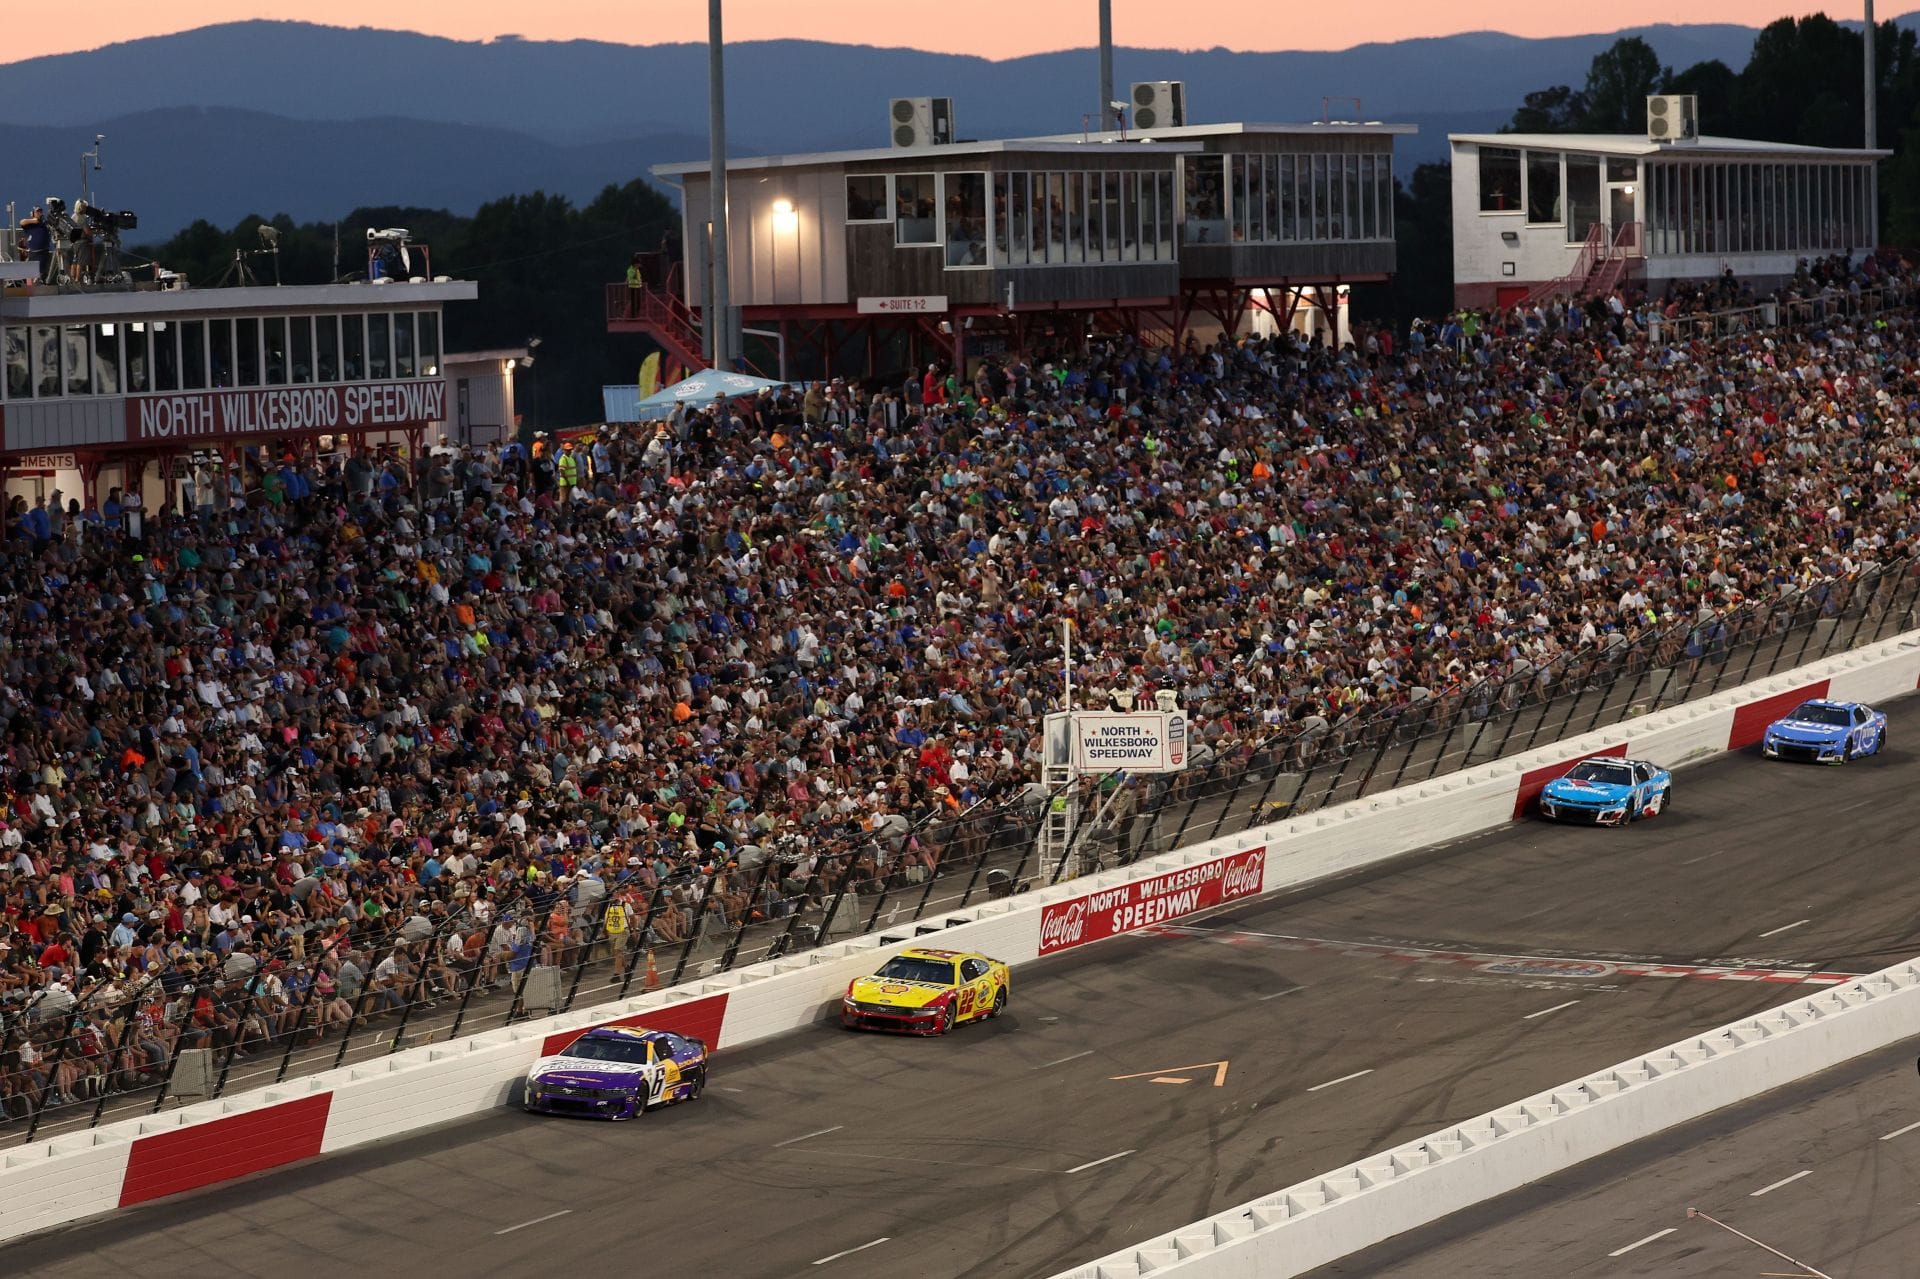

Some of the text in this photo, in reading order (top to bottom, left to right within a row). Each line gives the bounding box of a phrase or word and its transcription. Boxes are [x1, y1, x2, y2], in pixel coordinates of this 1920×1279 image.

[889, 298, 926, 310] SUITE 1-2
[139, 381, 446, 438] NORTH WILKESBORO SPEEDWAY
[1084, 737, 1158, 747] WILKESBORO
[1101, 726, 1141, 736] NORTH
[1089, 748, 1153, 758] SPEEDWAY
[1090, 860, 1223, 913] NORTH WILKESBORO
[1111, 886, 1202, 933] SPEEDWAY
[958, 987, 976, 1016] 22
[651, 1065, 666, 1097] 6
